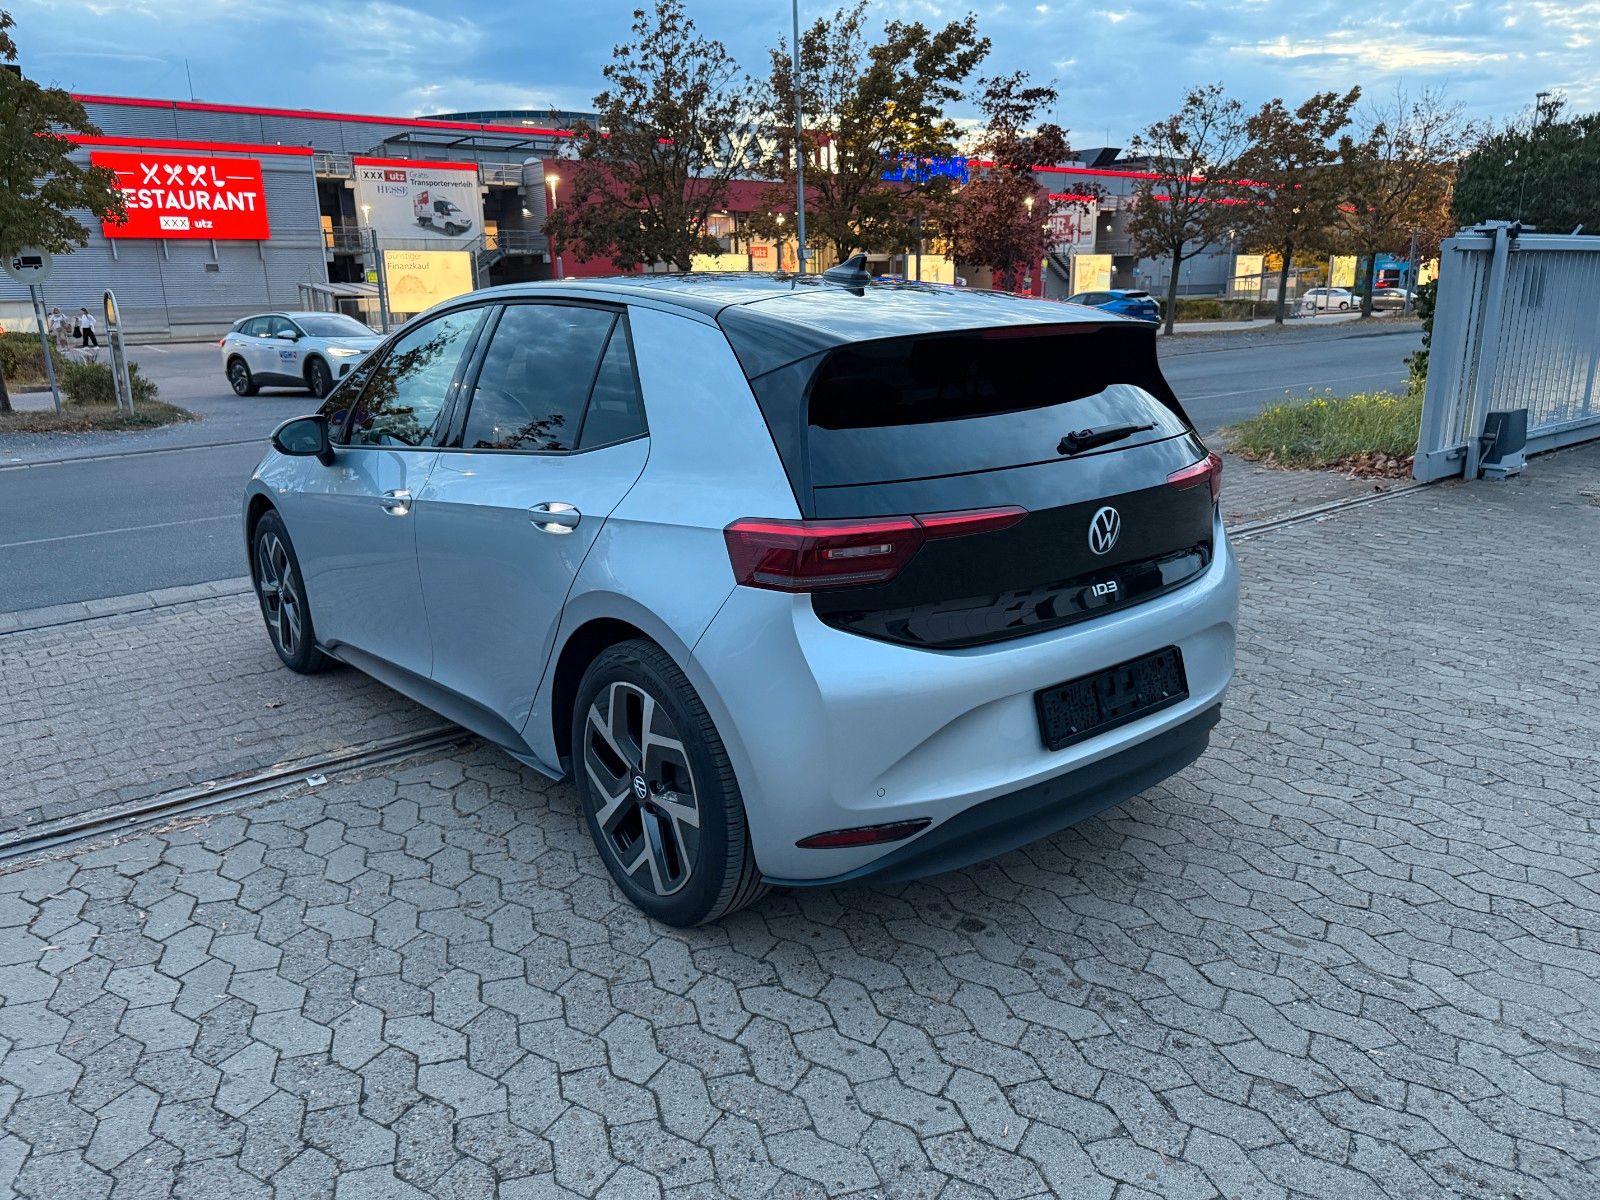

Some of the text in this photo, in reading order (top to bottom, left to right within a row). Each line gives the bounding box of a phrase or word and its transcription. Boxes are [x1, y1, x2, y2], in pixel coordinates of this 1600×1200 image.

[139, 162, 226, 188] XXXL
[410, 179, 473, 188] Transporterverleih
[110, 188, 257, 212] ESTAURANT
[387, 262, 430, 271] Finanzkauf
